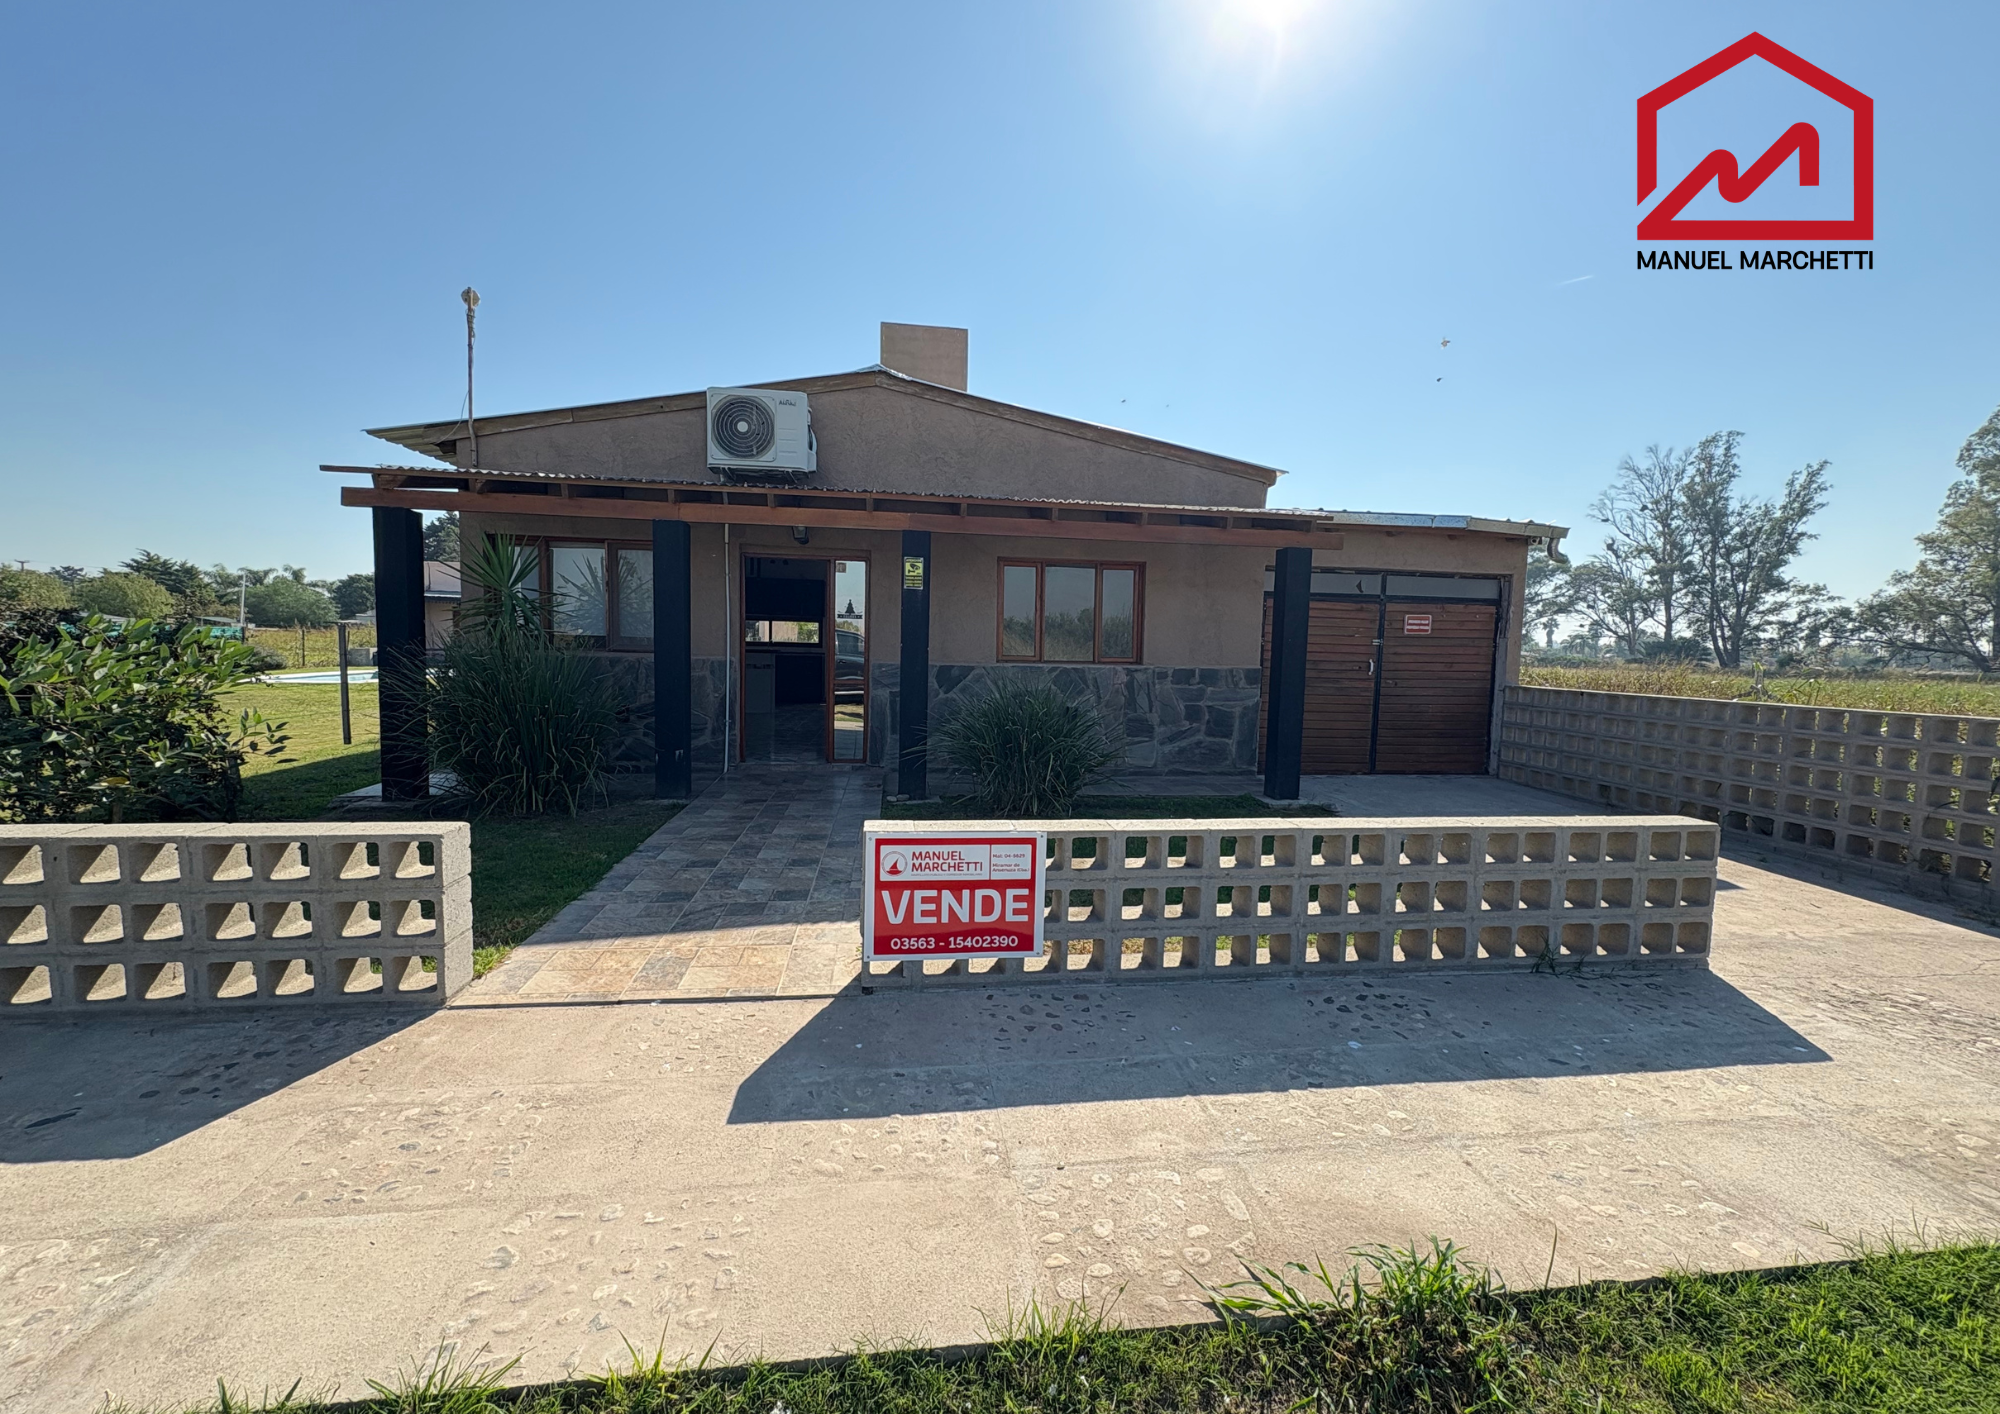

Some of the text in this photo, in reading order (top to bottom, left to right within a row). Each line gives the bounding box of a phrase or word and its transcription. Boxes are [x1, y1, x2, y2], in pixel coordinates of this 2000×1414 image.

[911, 851, 965, 862] MANUEL
[911, 861, 983, 873] MARCHETTI
[881, 889, 1029, 925] VENDE
[890, 937, 935, 950] 03563
[948, 935, 1018, 949] 15402390
